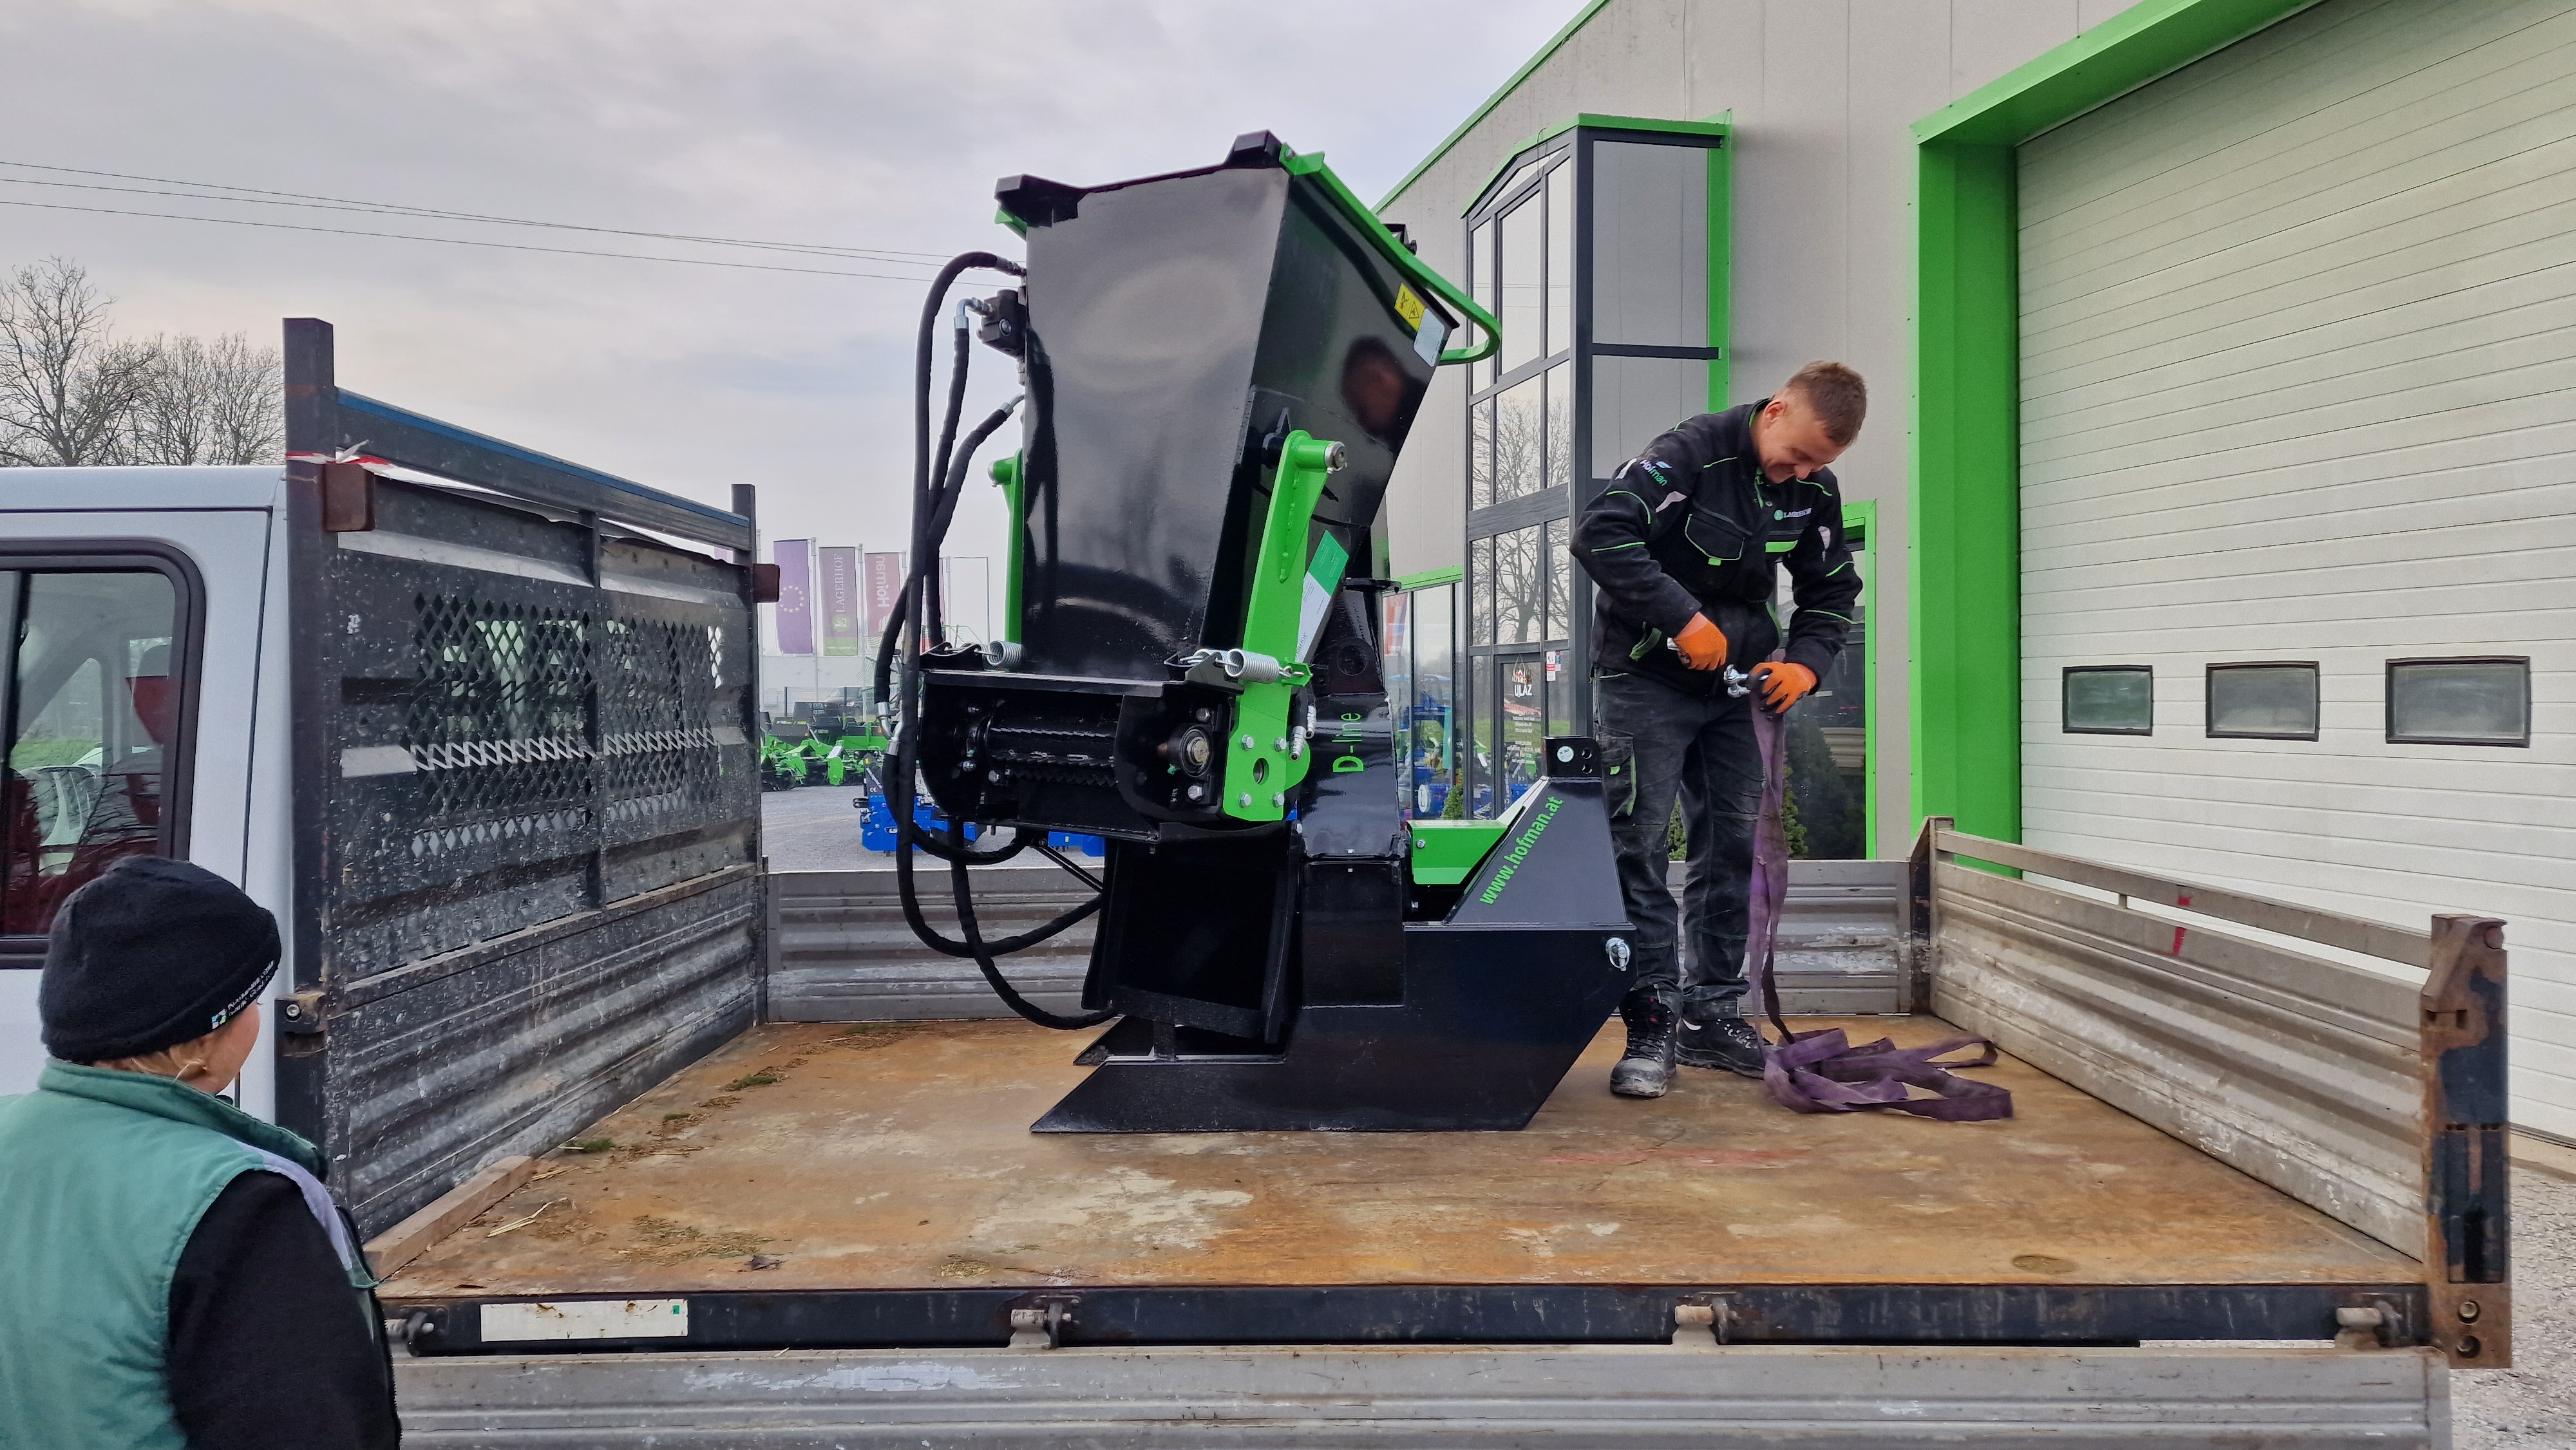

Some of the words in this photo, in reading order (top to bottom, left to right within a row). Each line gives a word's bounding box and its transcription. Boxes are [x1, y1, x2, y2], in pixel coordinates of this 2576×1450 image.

[1640, 460, 1668, 486] Hofman
[833, 553, 845, 612] LAGERHOF
[1515, 684, 1532, 696] ULAZ
[1332, 713, 1364, 772] D-line
[1479, 796, 1563, 905] www.hofman.at
